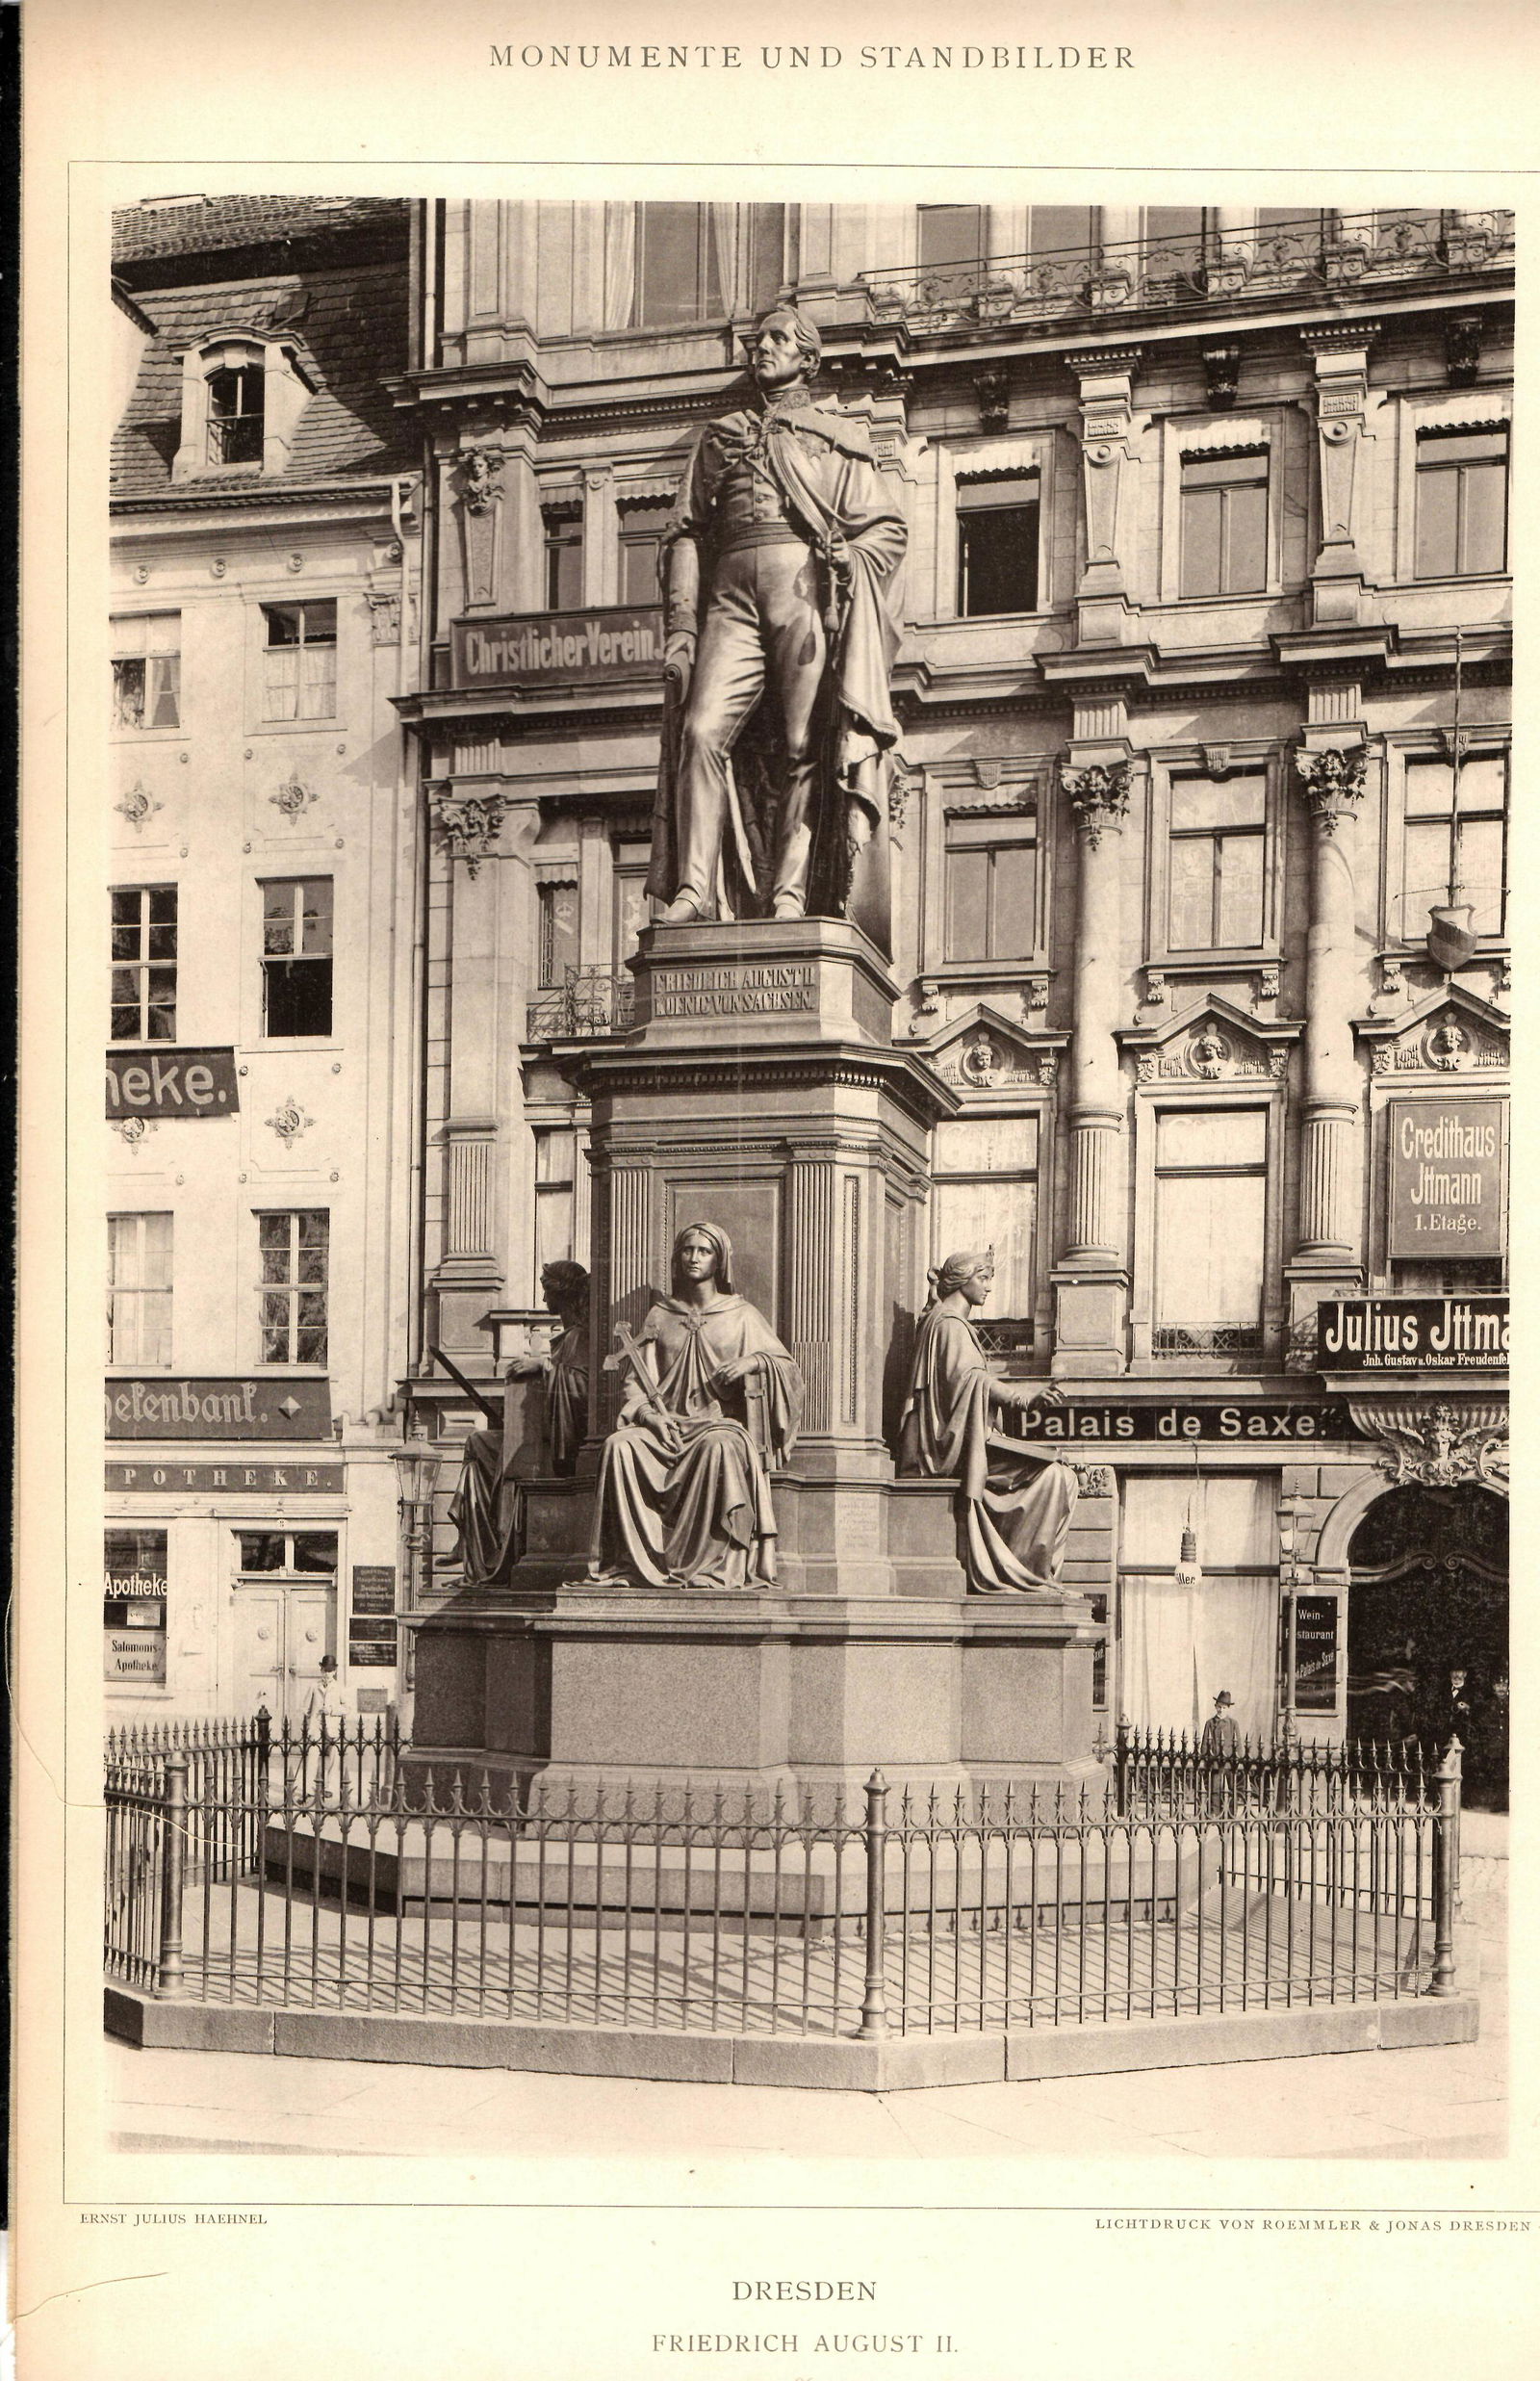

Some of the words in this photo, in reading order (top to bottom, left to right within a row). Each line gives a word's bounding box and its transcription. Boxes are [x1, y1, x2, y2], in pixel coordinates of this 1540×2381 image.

[466, 626, 589, 674] Christlicher
[585, 620, 654, 666] Verein
[654, 971, 738, 994] FRIEDRICH
[742, 967, 802, 990] AUGUST
[1401, 1116, 1496, 1159] Credithaus
[1325, 1301, 1419, 1353] Julius
[1384, 1354, 1418, 1366] Gustav
[1425, 1354, 1456, 1365] Oskar
[1020, 1410, 1135, 1437] Palais
[1158, 1408, 1202, 1436] de
[104, 1571, 167, 1599] Apotheke
[1297, 1609, 1323, 1620] Wein-
[112, 1639, 162, 1653] Salomonis-
[1285, 1628, 1334, 1640] Rstaurant
